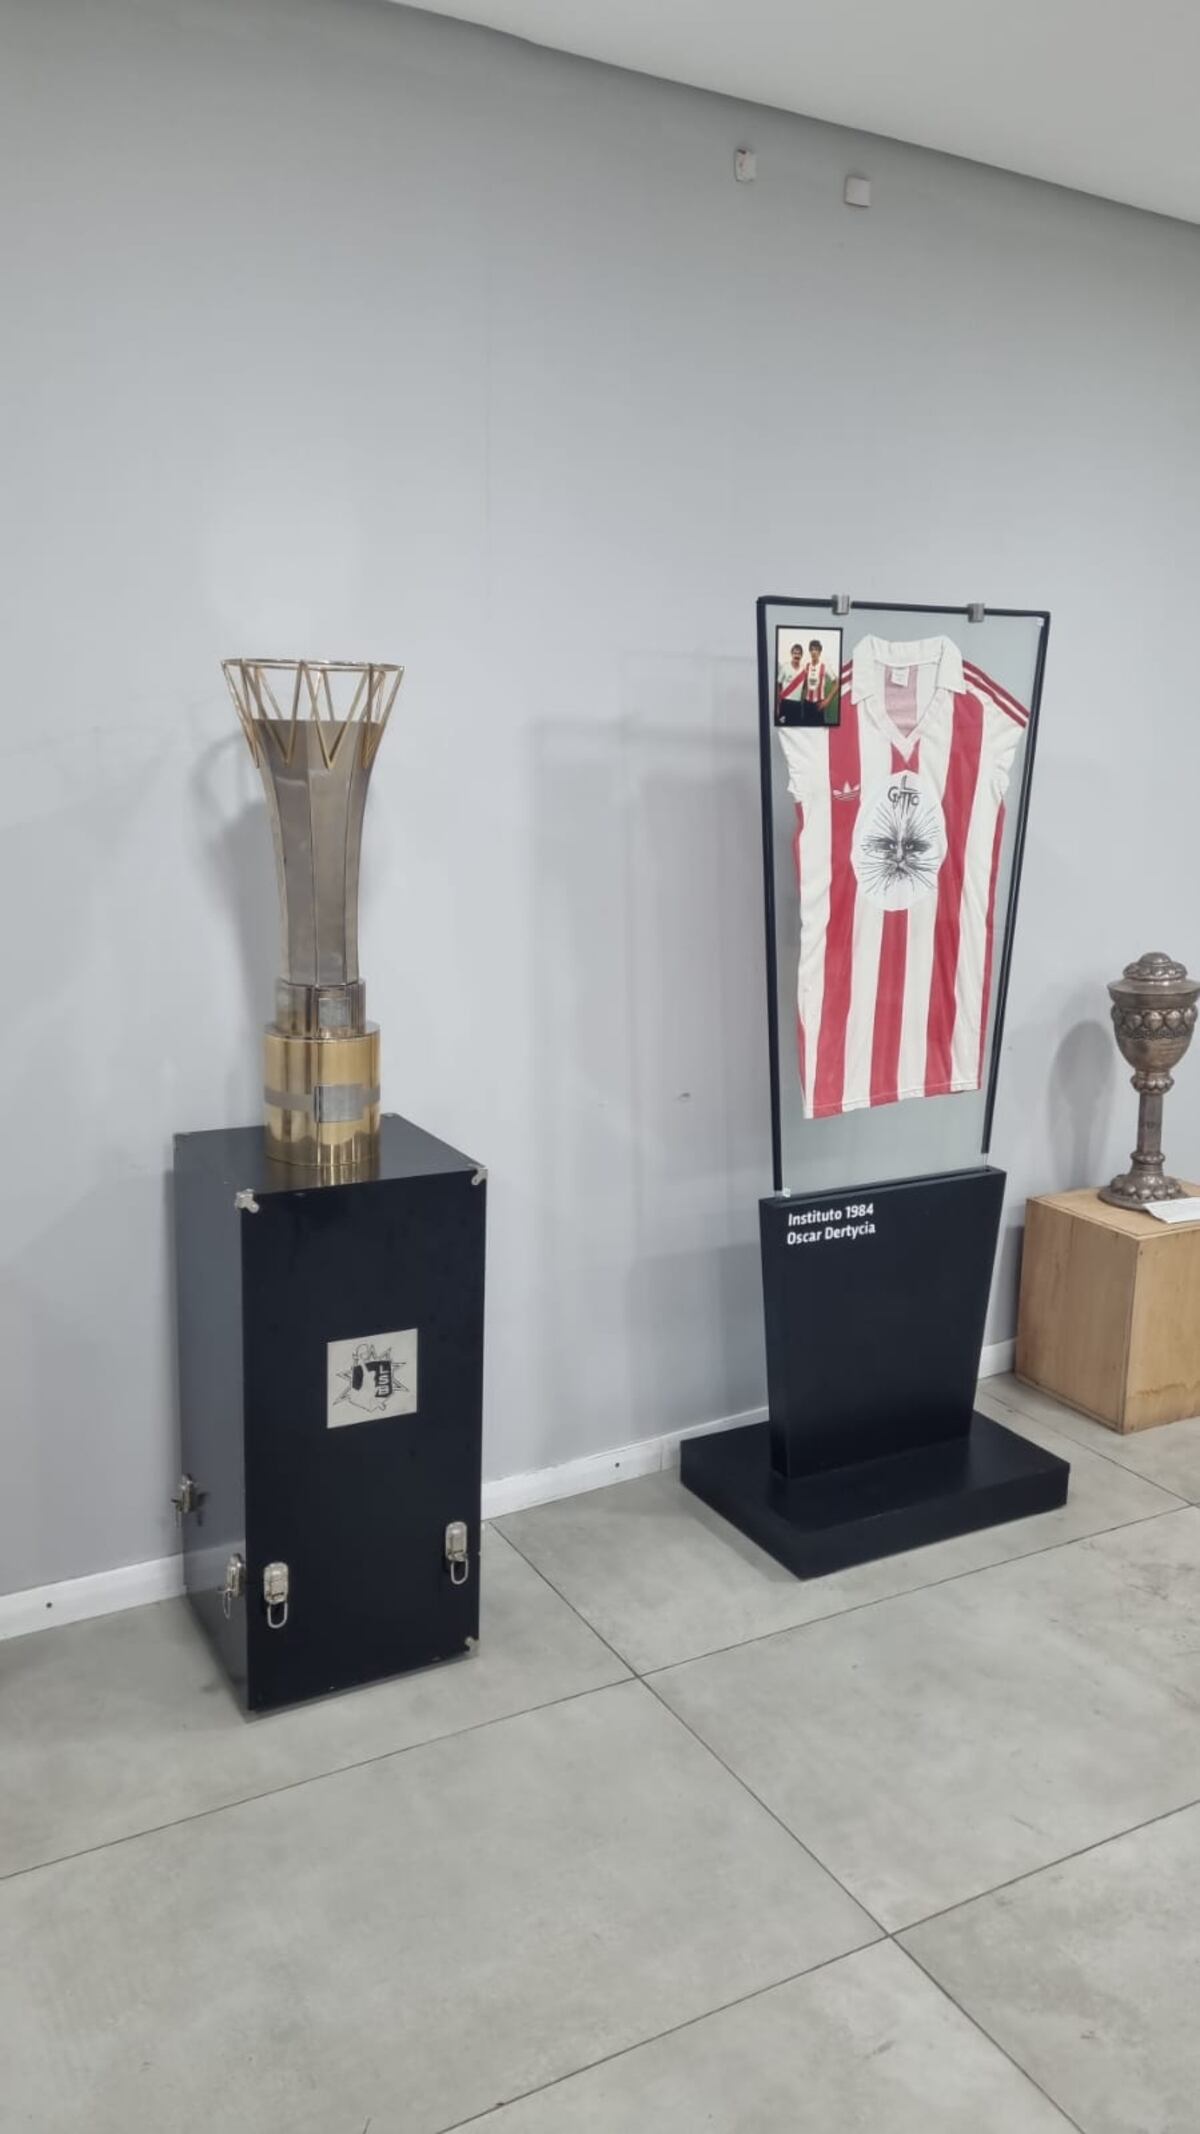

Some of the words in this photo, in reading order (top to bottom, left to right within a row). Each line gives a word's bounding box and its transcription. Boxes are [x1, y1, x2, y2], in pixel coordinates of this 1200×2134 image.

[788, 1208, 842, 1226] Instituto
[845, 1203, 874, 1219] 1984
[787, 1231, 822, 1245] Oscar
[824, 1220, 876, 1240] Dertycia
